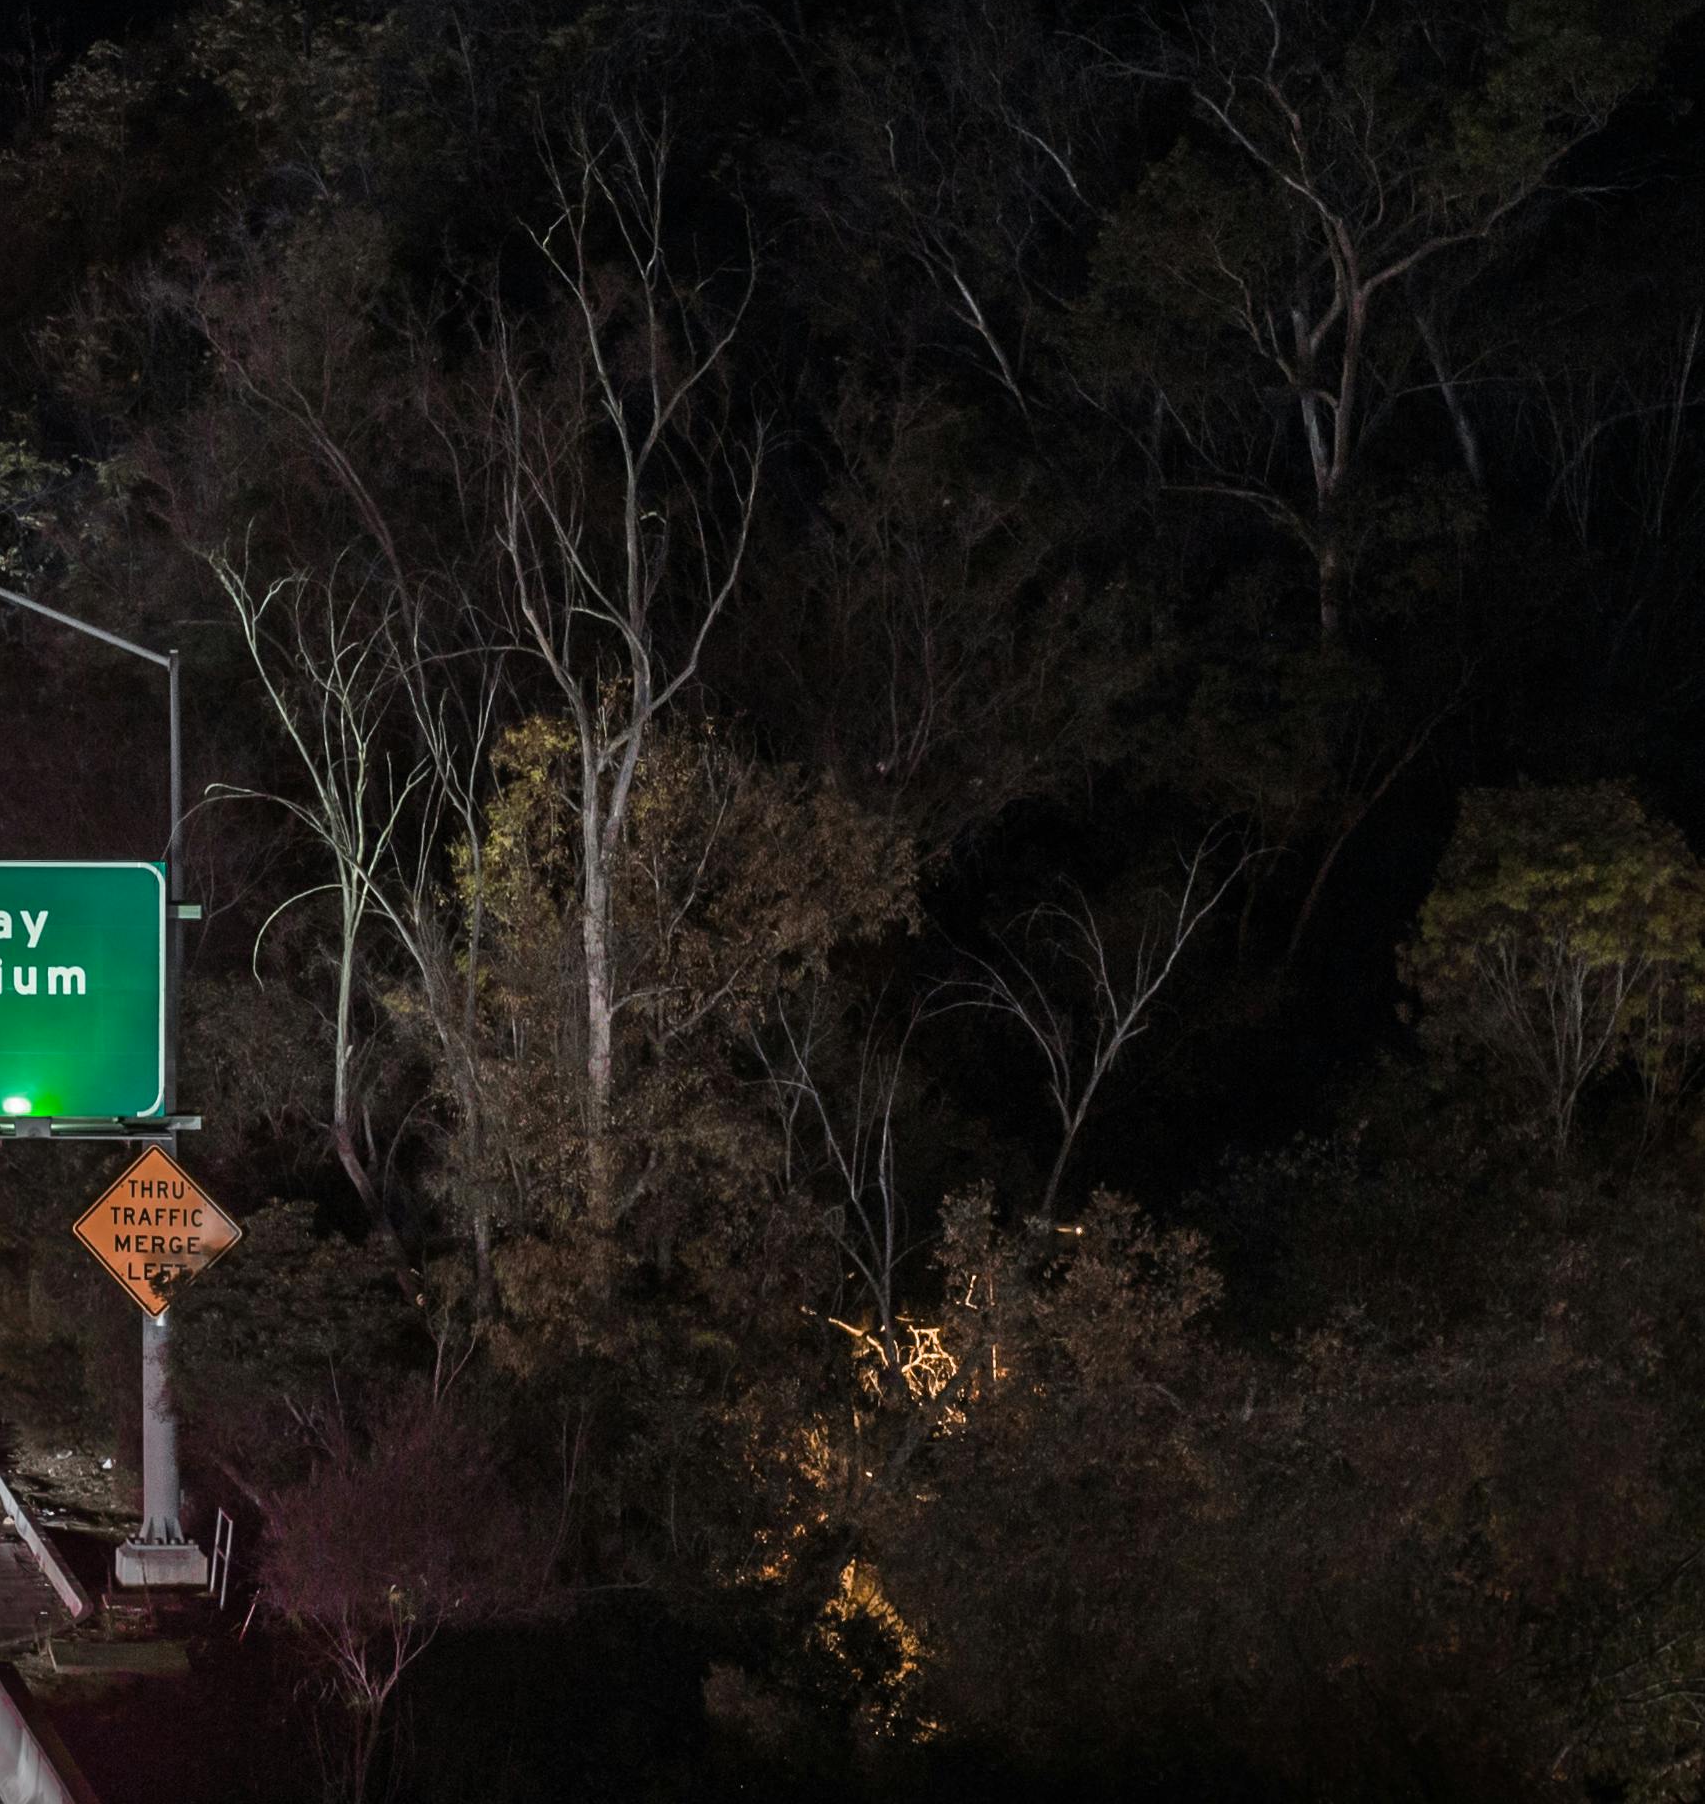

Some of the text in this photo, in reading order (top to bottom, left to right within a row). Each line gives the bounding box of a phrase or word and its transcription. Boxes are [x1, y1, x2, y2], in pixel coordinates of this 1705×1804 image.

[128, 1179, 184, 1200] THRU
[110, 1207, 203, 1227] TRAFFIC
[114, 1234, 201, 1255] MERGE
